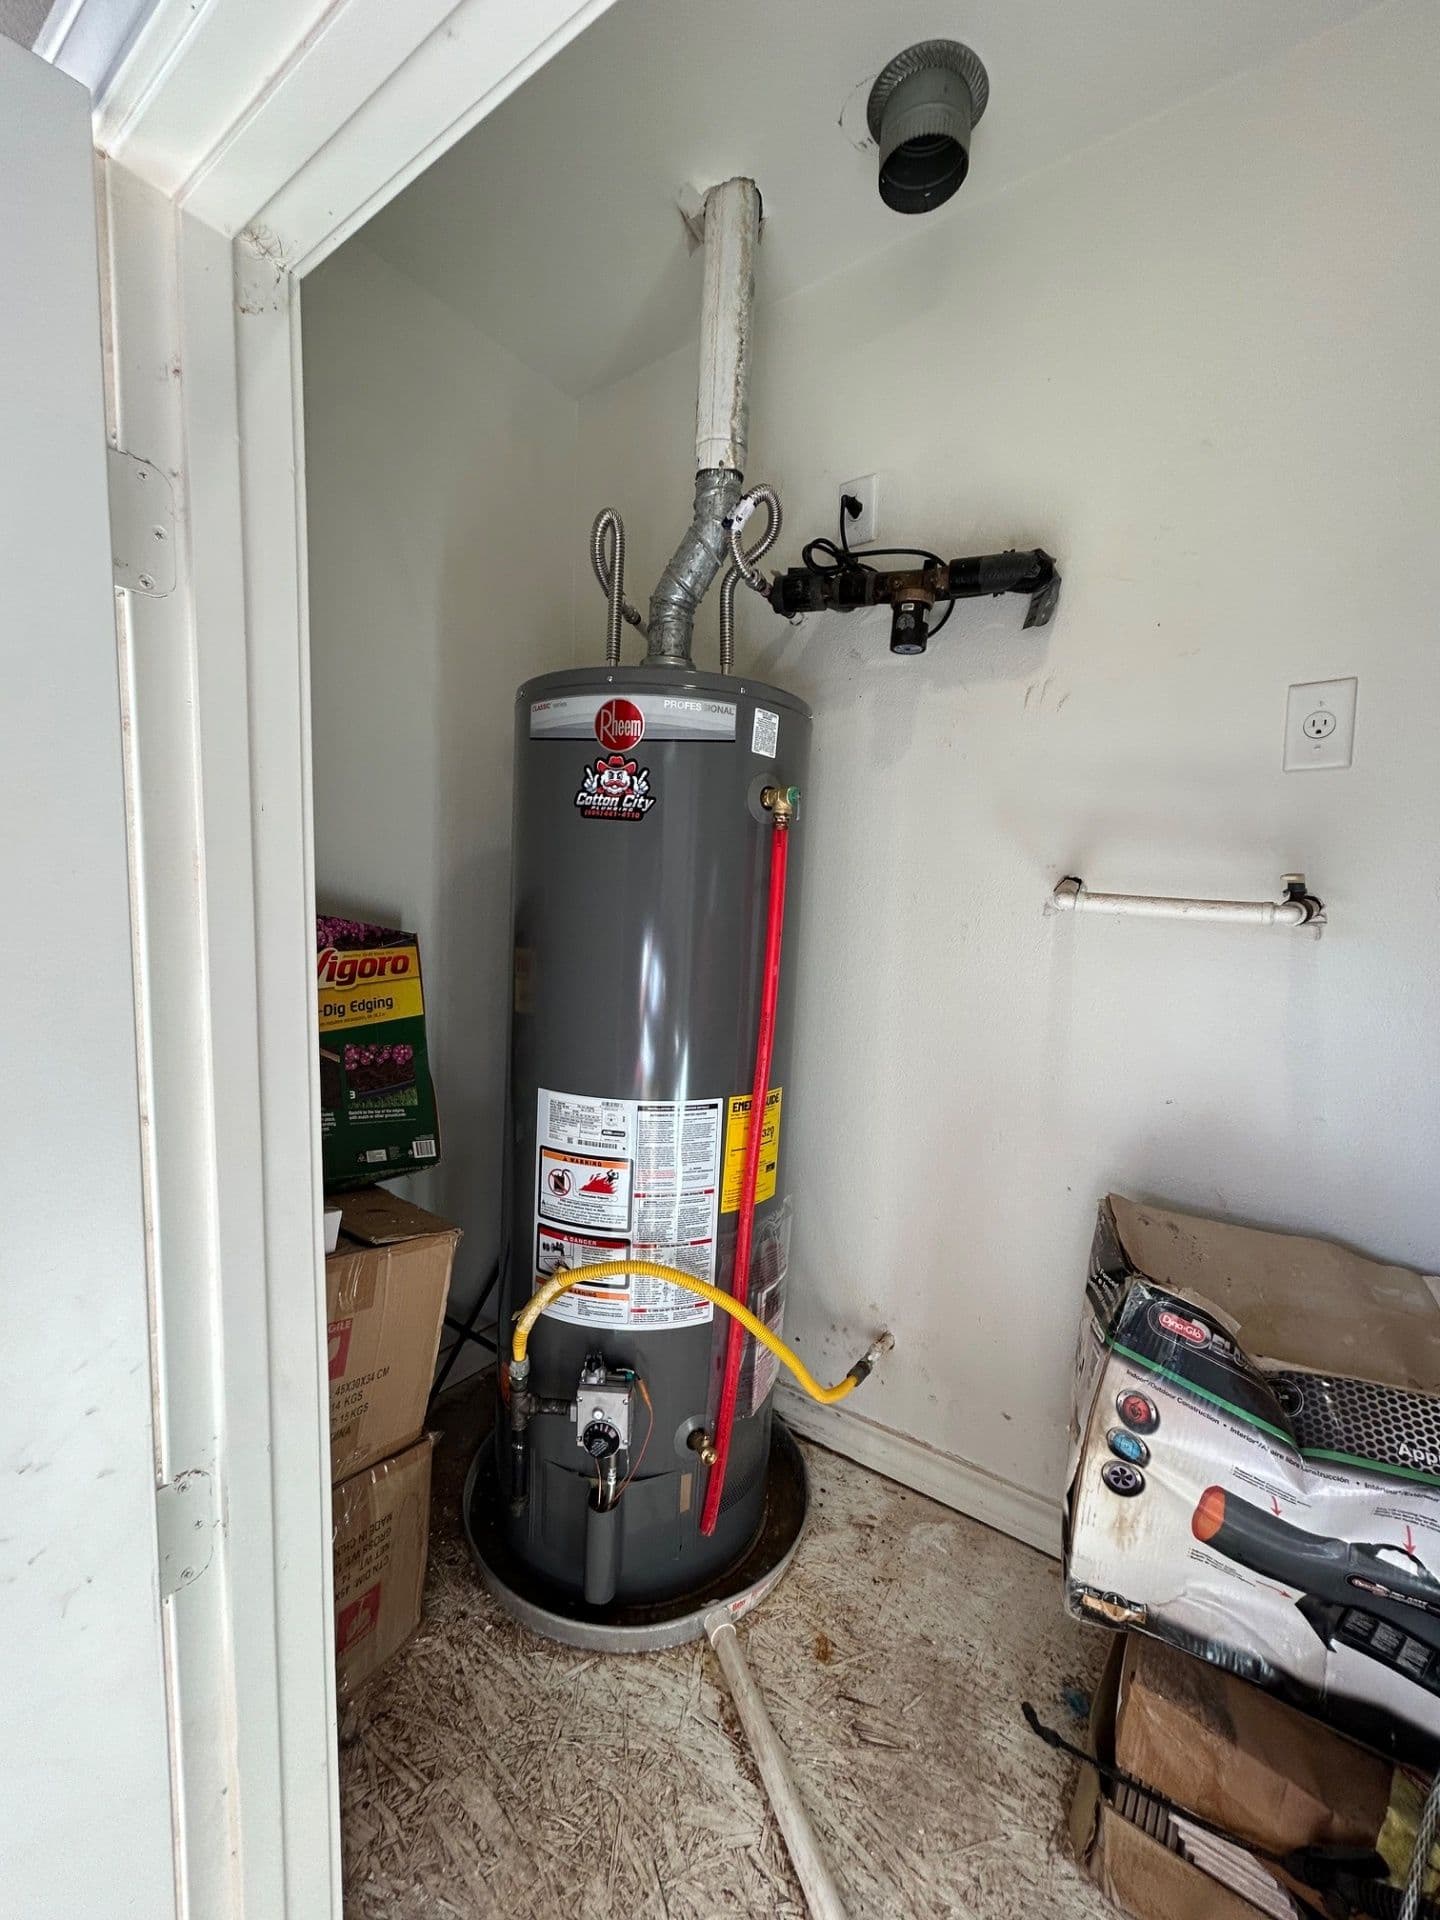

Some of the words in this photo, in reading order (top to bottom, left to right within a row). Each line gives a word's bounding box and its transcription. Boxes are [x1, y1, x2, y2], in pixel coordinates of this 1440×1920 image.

[600, 700, 641, 744] Rheem
[576, 792, 620, 806] Cotton
[622, 793, 655, 812] City
[350, 997, 394, 1013] Edging
[570, 1156, 603, 1168] WARNING
[569, 1236, 597, 1246] DANGER
[343, 1390, 364, 1408] KGS
[1176, 1396, 1220, 1425] Construction
